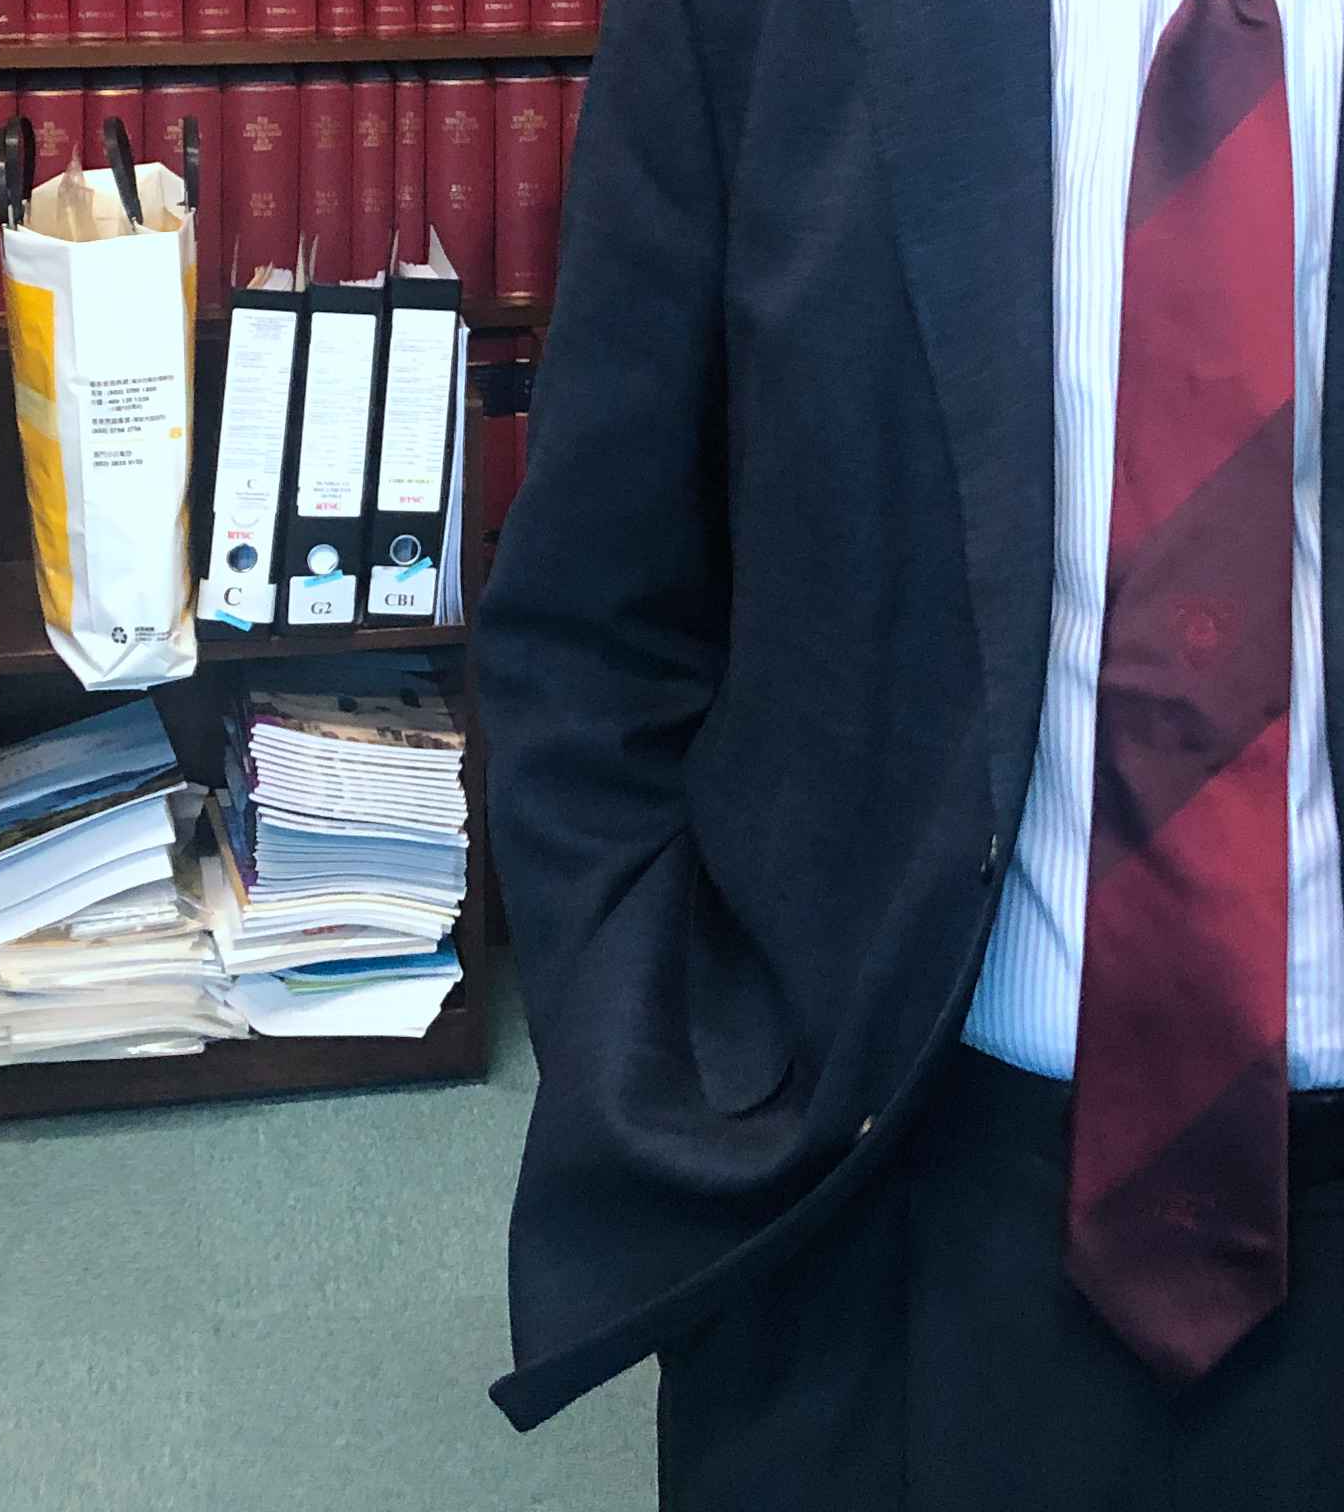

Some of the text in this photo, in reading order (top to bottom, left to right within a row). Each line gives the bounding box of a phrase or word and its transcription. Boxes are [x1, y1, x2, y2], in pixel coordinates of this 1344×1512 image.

[223, 586, 243, 606] C
[384, 593, 415, 607] CB1
[311, 601, 332, 614] G2
